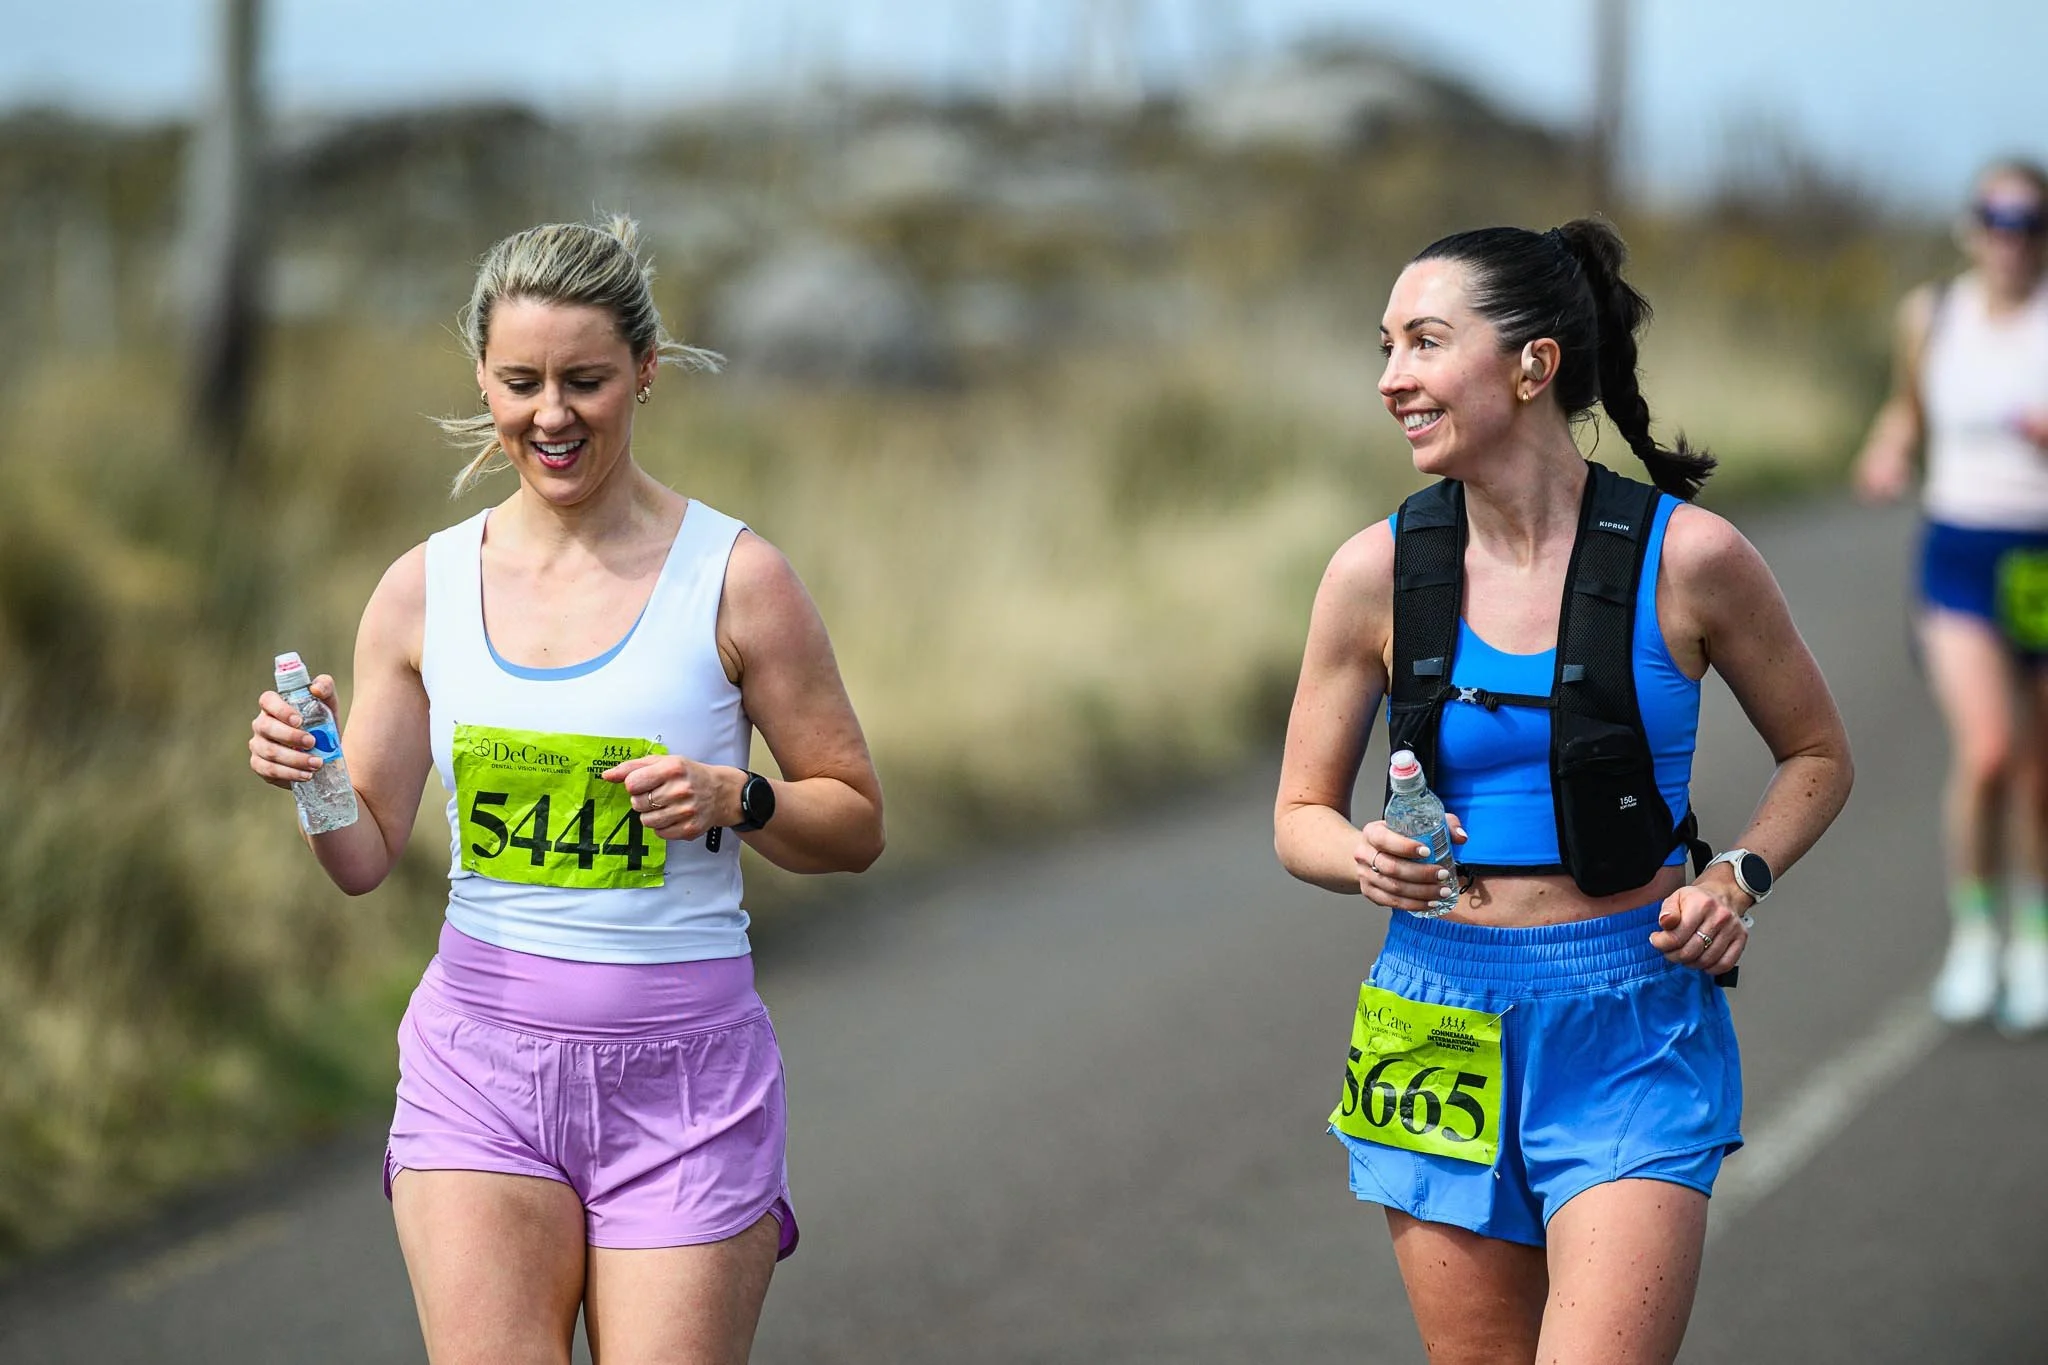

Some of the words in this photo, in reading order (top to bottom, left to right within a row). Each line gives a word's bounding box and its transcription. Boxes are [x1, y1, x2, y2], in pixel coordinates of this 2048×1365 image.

[1599, 521, 1630, 531] KIPRUN
[493, 742, 570, 767] DeCare
[592, 759, 623, 767] CONNE
[470, 790, 649, 872] 5444
[1427, 1034, 1481, 1048] INTERNATIONAL
[1431, 1028, 1475, 1041] CONNEMARA
[1435, 1041, 1475, 1053] MARATHON
[1341, 1045, 1488, 1142] 5665
